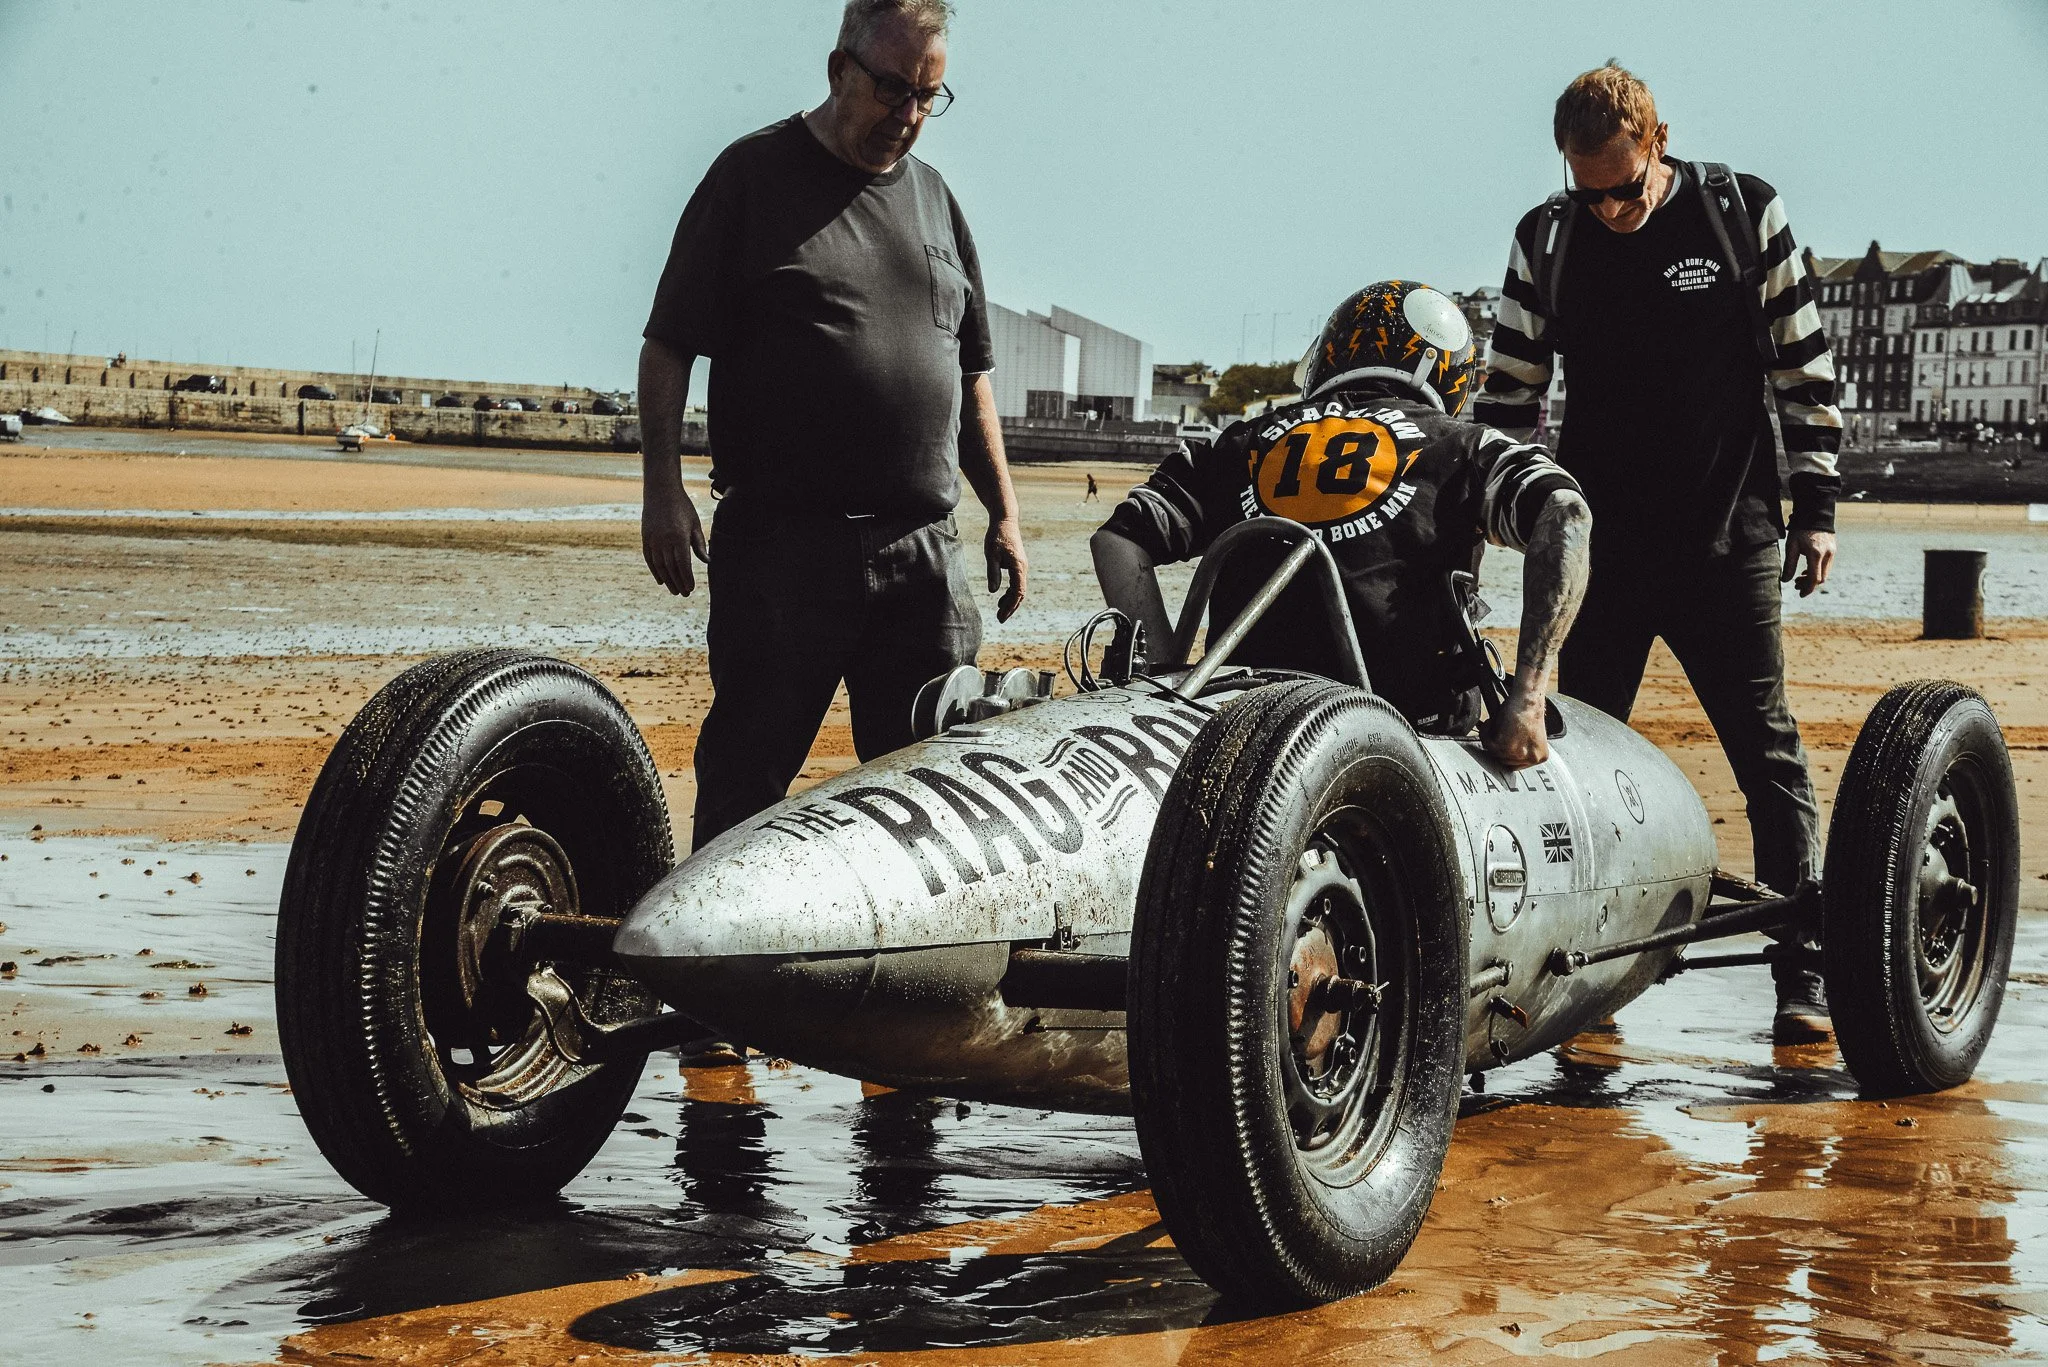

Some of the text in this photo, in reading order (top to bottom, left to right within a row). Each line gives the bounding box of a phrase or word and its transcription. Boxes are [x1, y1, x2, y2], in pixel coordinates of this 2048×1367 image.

[1664, 265, 1678, 278] RAG
[1685, 258, 1704, 267] BONE
[1704, 259, 1721, 273] MAN
[1679, 268, 1708, 279] MARGATE
[1273, 431, 1380, 499] 18
[1240, 484, 1259, 520] THE
[1330, 482, 1418, 543] BONE MAN
[1456, 768, 1556, 795] MALLE
[752, 803, 858, 842] THE
[826, 751, 1084, 898] RAG
[1057, 747, 1120, 811] AND
